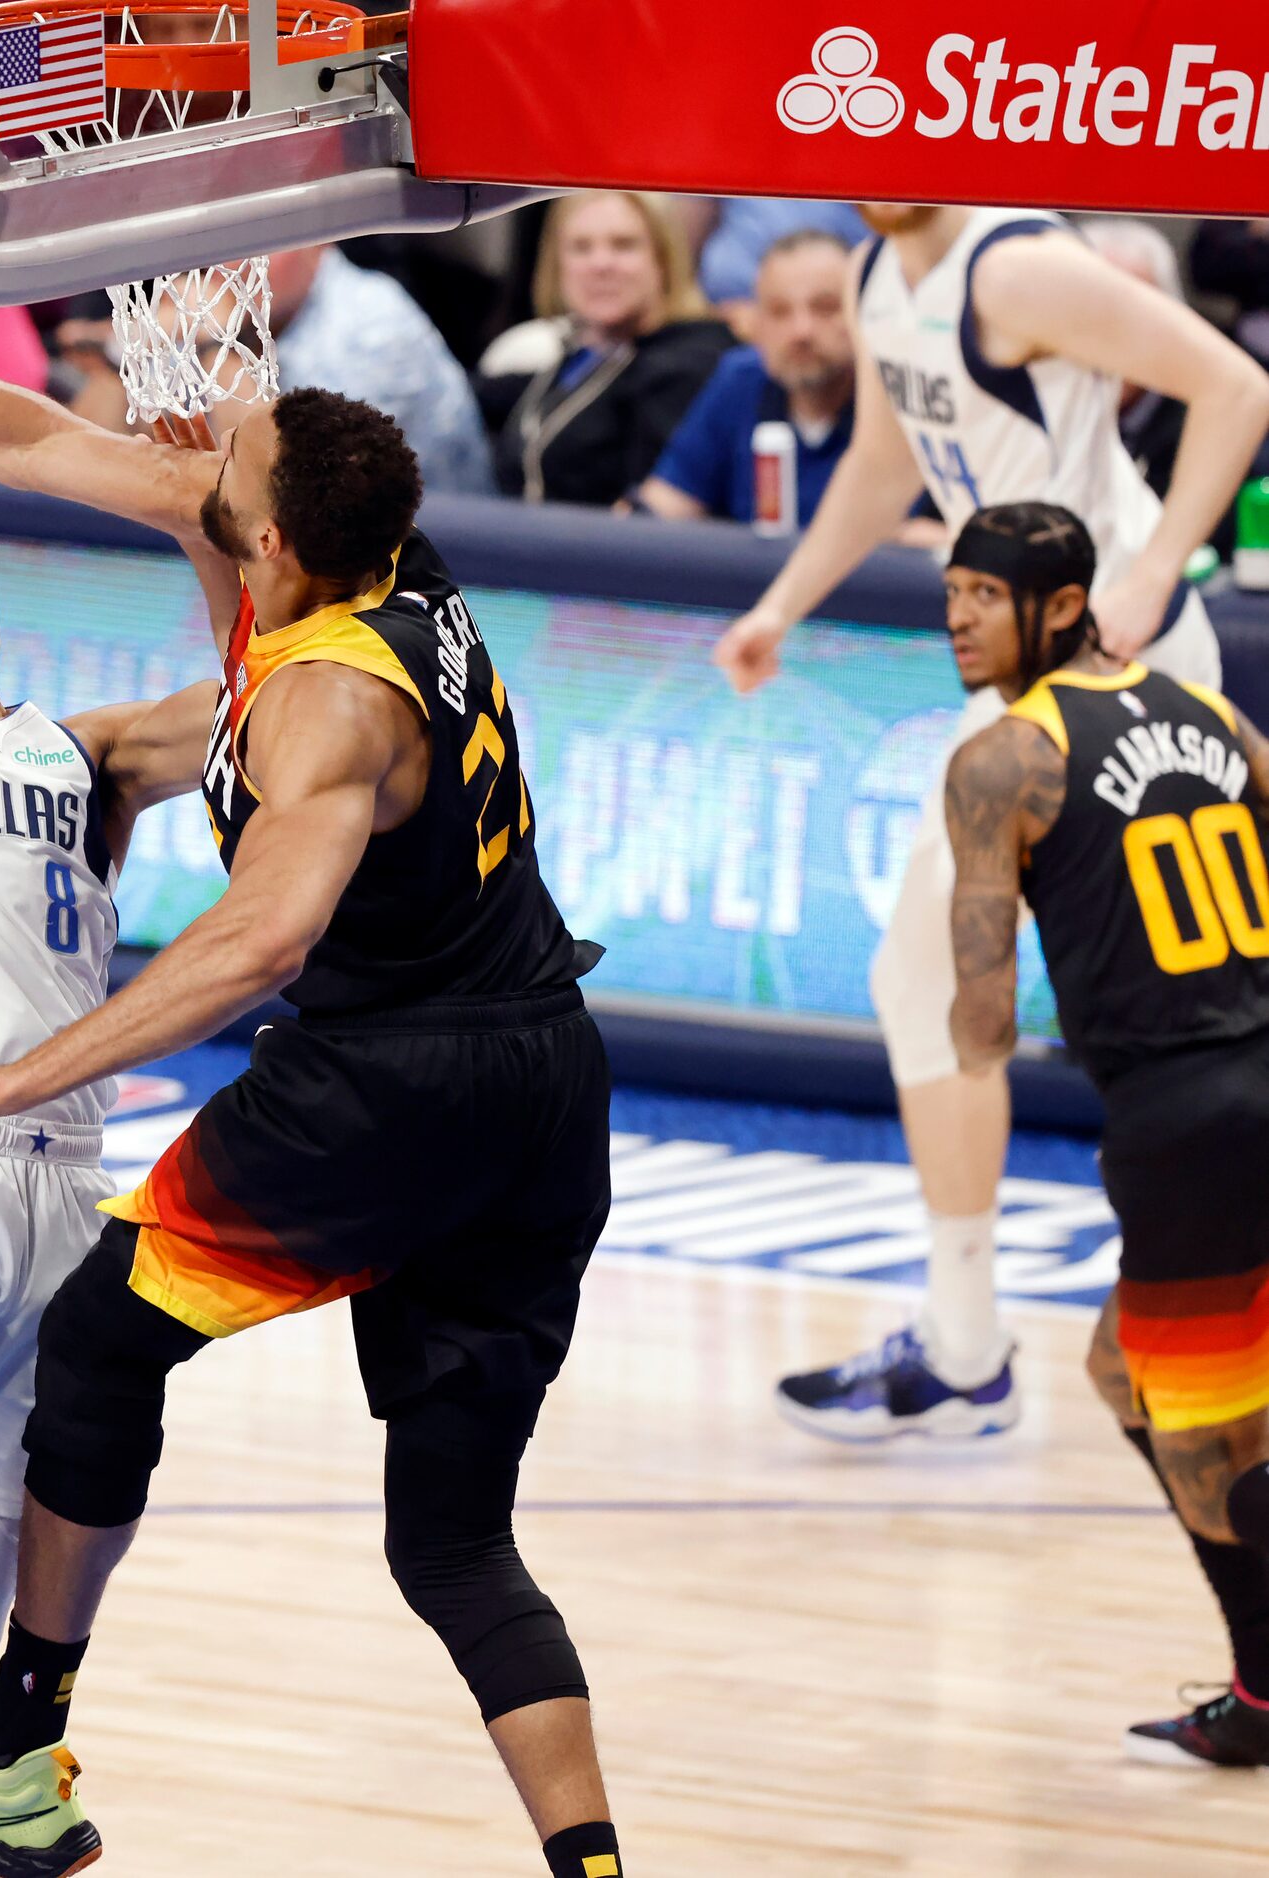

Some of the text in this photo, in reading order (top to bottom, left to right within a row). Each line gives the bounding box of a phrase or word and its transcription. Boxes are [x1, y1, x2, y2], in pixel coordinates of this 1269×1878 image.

[13, 746, 76, 767] chime
[1092, 720, 1249, 817] CLARKSON
[44, 858, 81, 957] 8
[1121, 801, 1269, 976] 00
